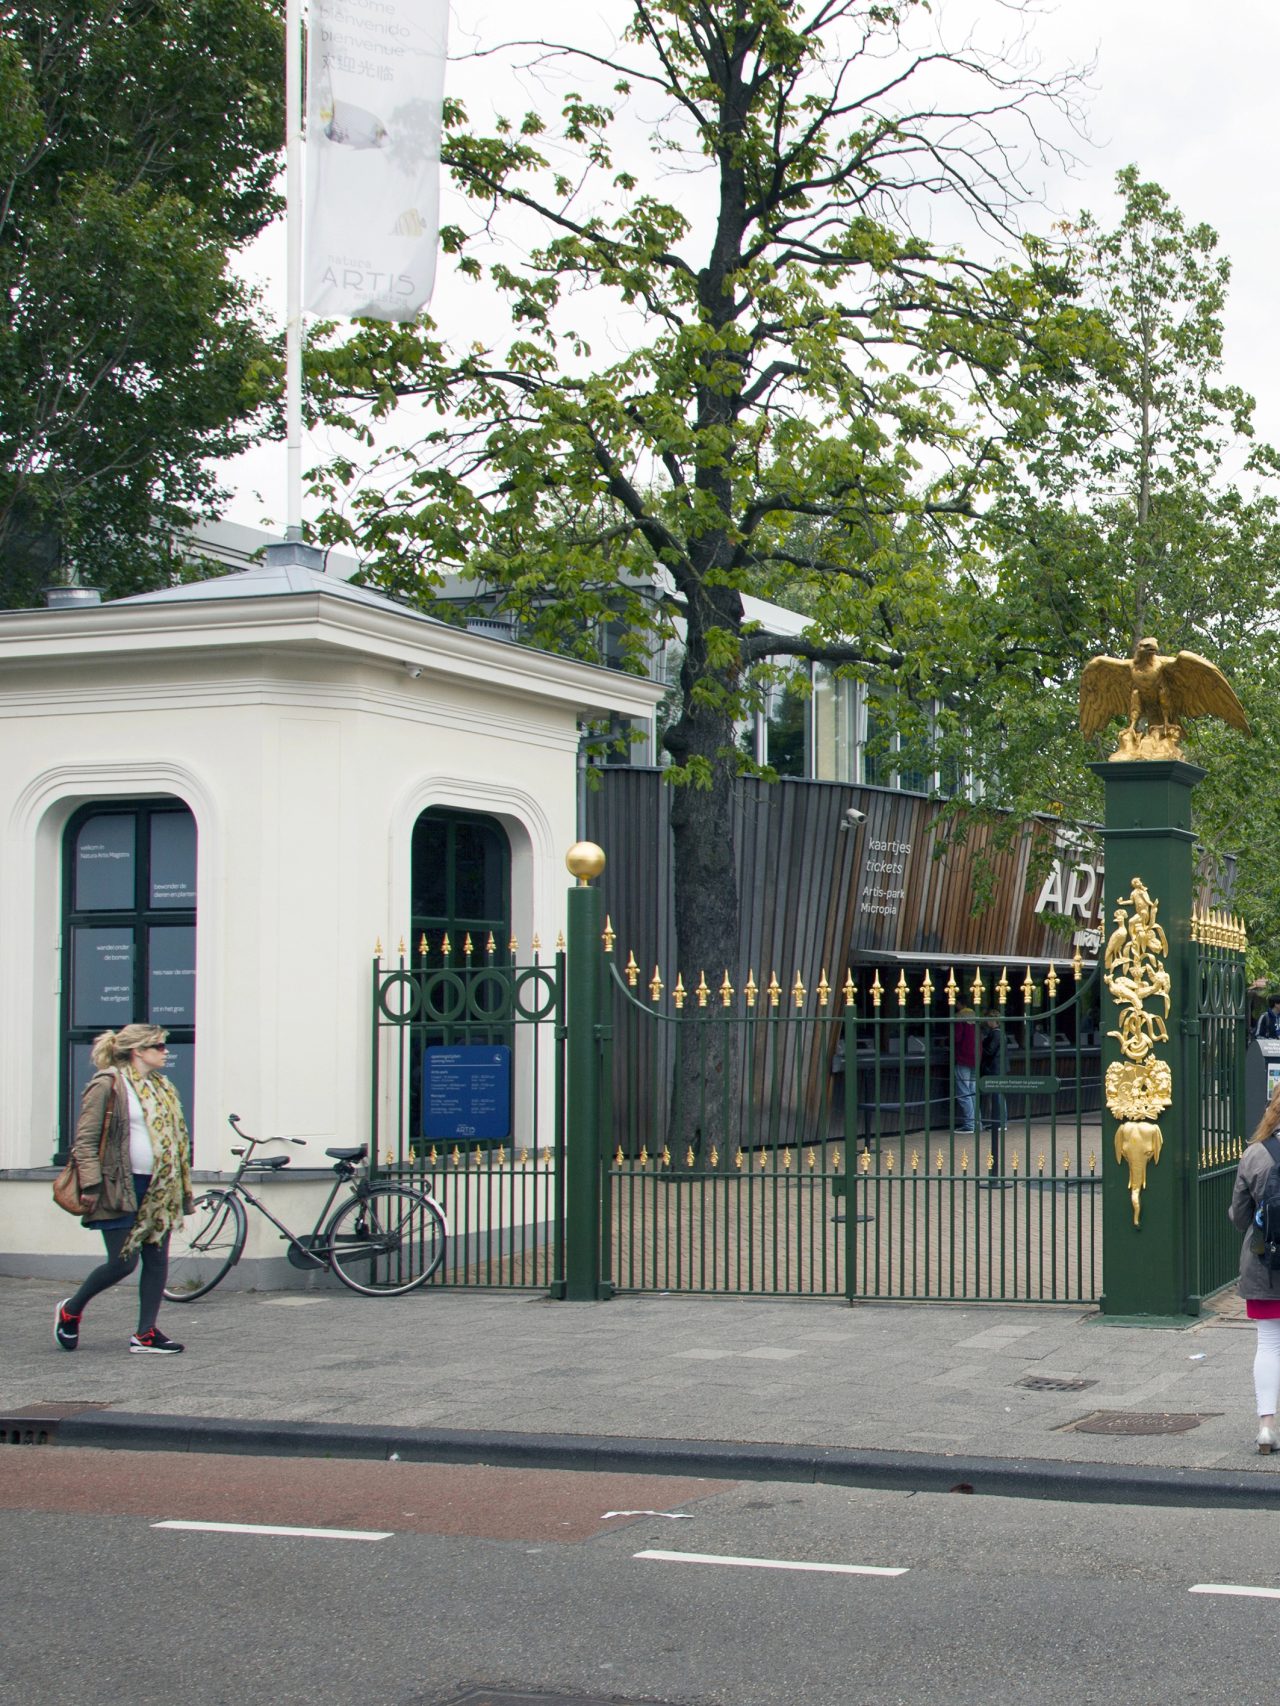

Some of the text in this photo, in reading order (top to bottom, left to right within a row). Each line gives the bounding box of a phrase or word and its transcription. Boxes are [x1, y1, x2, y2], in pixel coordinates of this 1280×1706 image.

[320, 5, 411, 38] bienvenido
[320, 28, 405, 57] bienvenue
[328, 255, 372, 269] natura
[321, 266, 416, 296] ARTIS
[868, 837, 911, 856] kaartjes
[866, 858, 903, 874] tickets
[862, 886, 905, 900] Artis-park
[860, 902, 897, 917] Micropia
